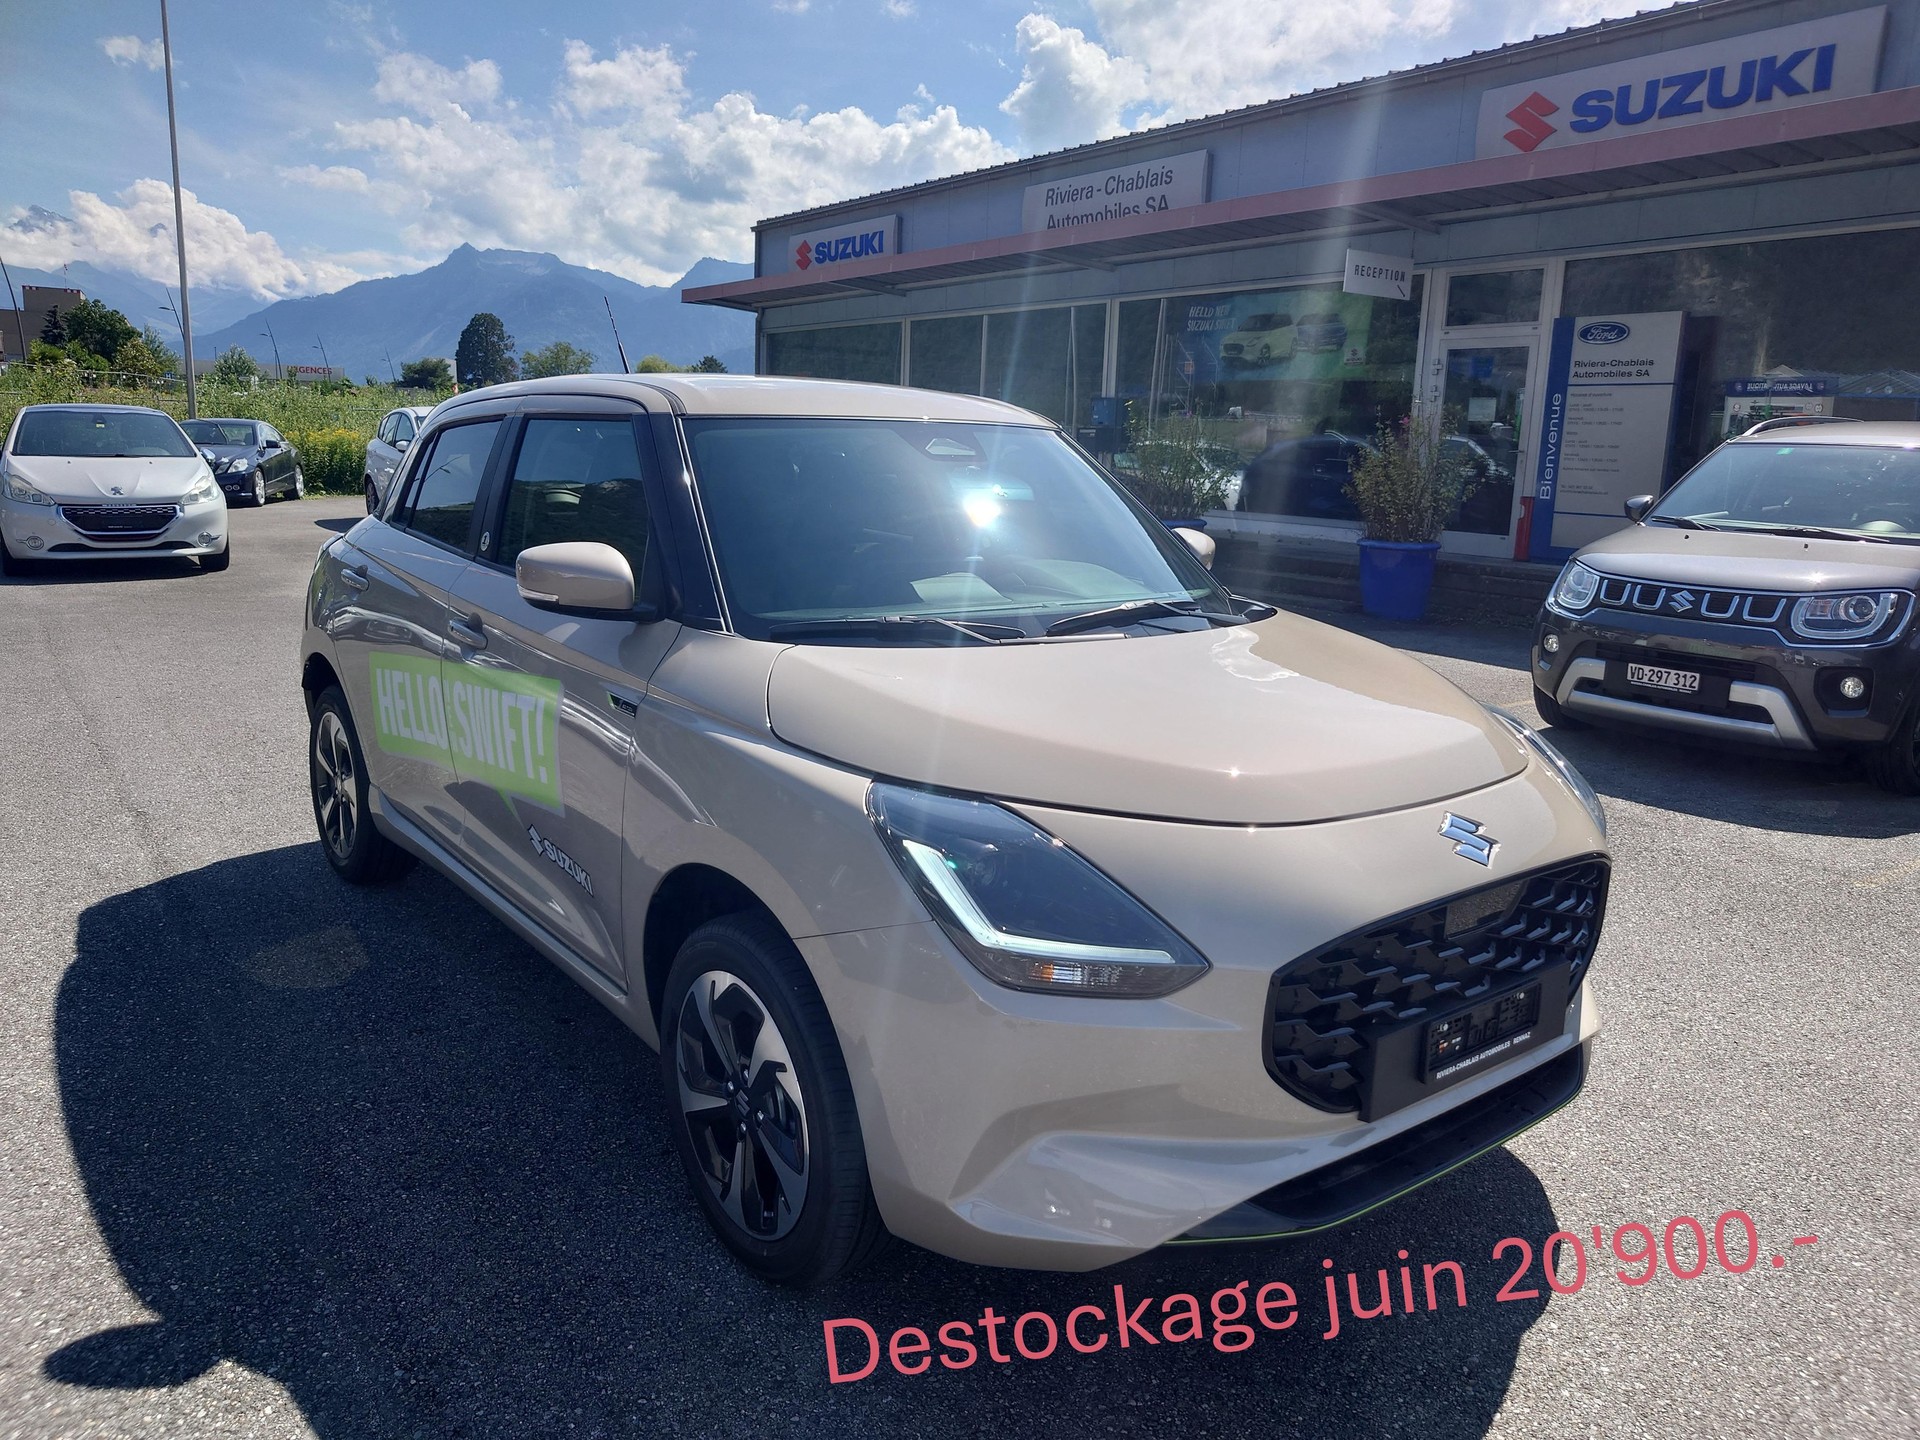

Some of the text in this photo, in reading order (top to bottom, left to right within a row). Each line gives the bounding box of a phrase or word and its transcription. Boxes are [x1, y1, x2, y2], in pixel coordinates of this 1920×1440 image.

[1569, 43, 1836, 133] SUZUKI
[1045, 184, 1094, 207] Riviera
[1104, 165, 1173, 196] Chablais
[1145, 194, 1169, 214] SA
[814, 229, 884, 264] SUZUKI
[1354, 264, 1406, 282] RECEPTION
[1188, 306, 1214, 318] HELLO
[1186, 319, 1214, 331] SUZUKI
[1587, 325, 1619, 340] Ford
[287, 365, 333, 375] GENCES
[1573, 358, 1655, 368] Riviera-Chablais
[1572, 369, 1650, 378] Automobiles SA
[1539, 392, 1562, 500] Bienvenue
[376, 668, 548, 784] HELLO SWIFT!
[542, 837, 595, 897] SUZUKI
[1436, 1031, 1531, 1079] RIVIERA-CHABLAIS AUTOMOBILES RENNAZ
